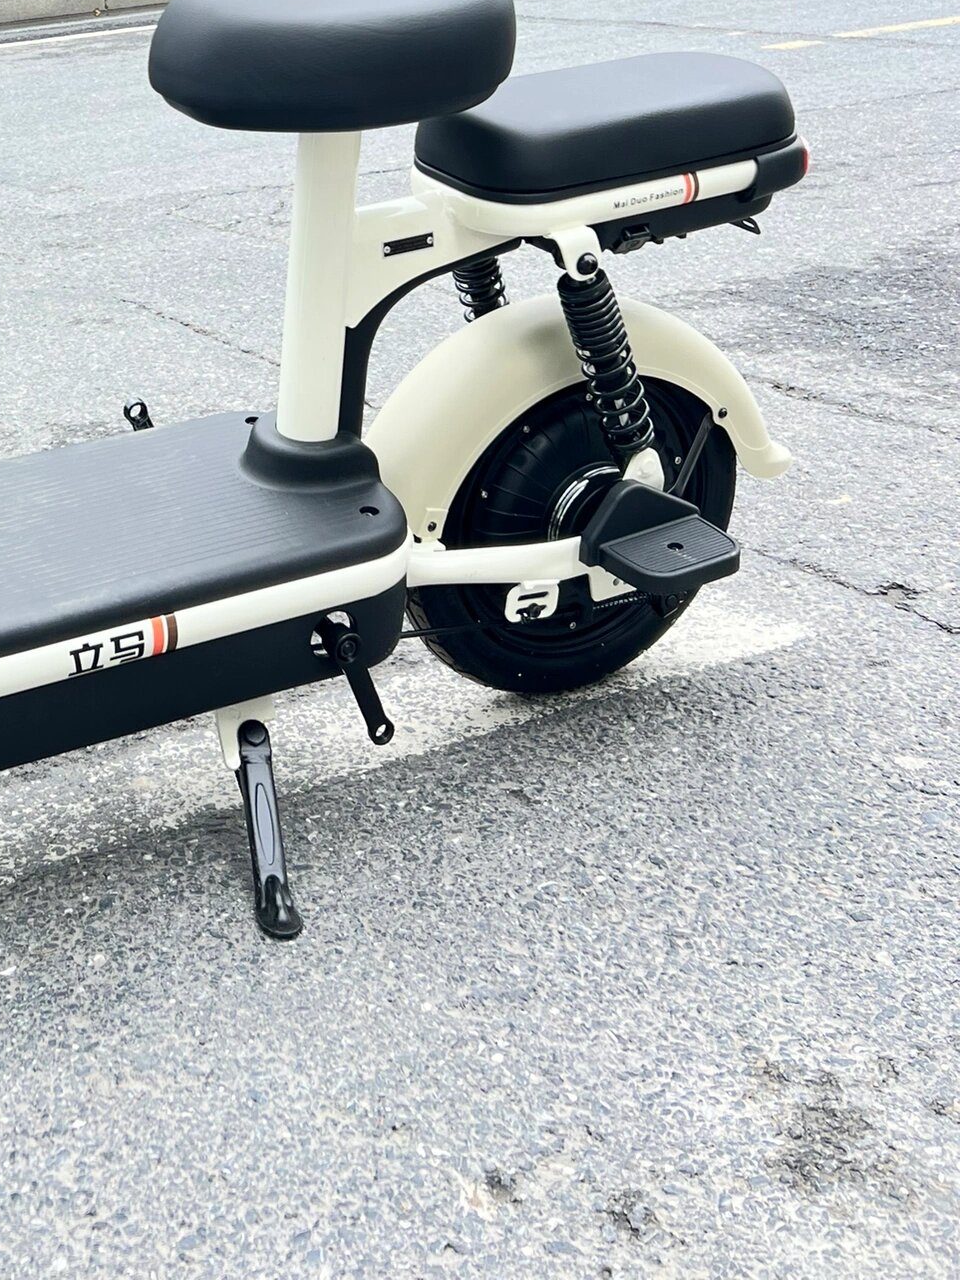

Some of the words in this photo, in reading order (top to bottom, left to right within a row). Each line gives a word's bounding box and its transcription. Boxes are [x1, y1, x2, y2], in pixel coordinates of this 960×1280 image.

[613, 199, 629, 209] Mai
[630, 196, 648, 206] Duo
[649, 188, 684, 201] Fashion
